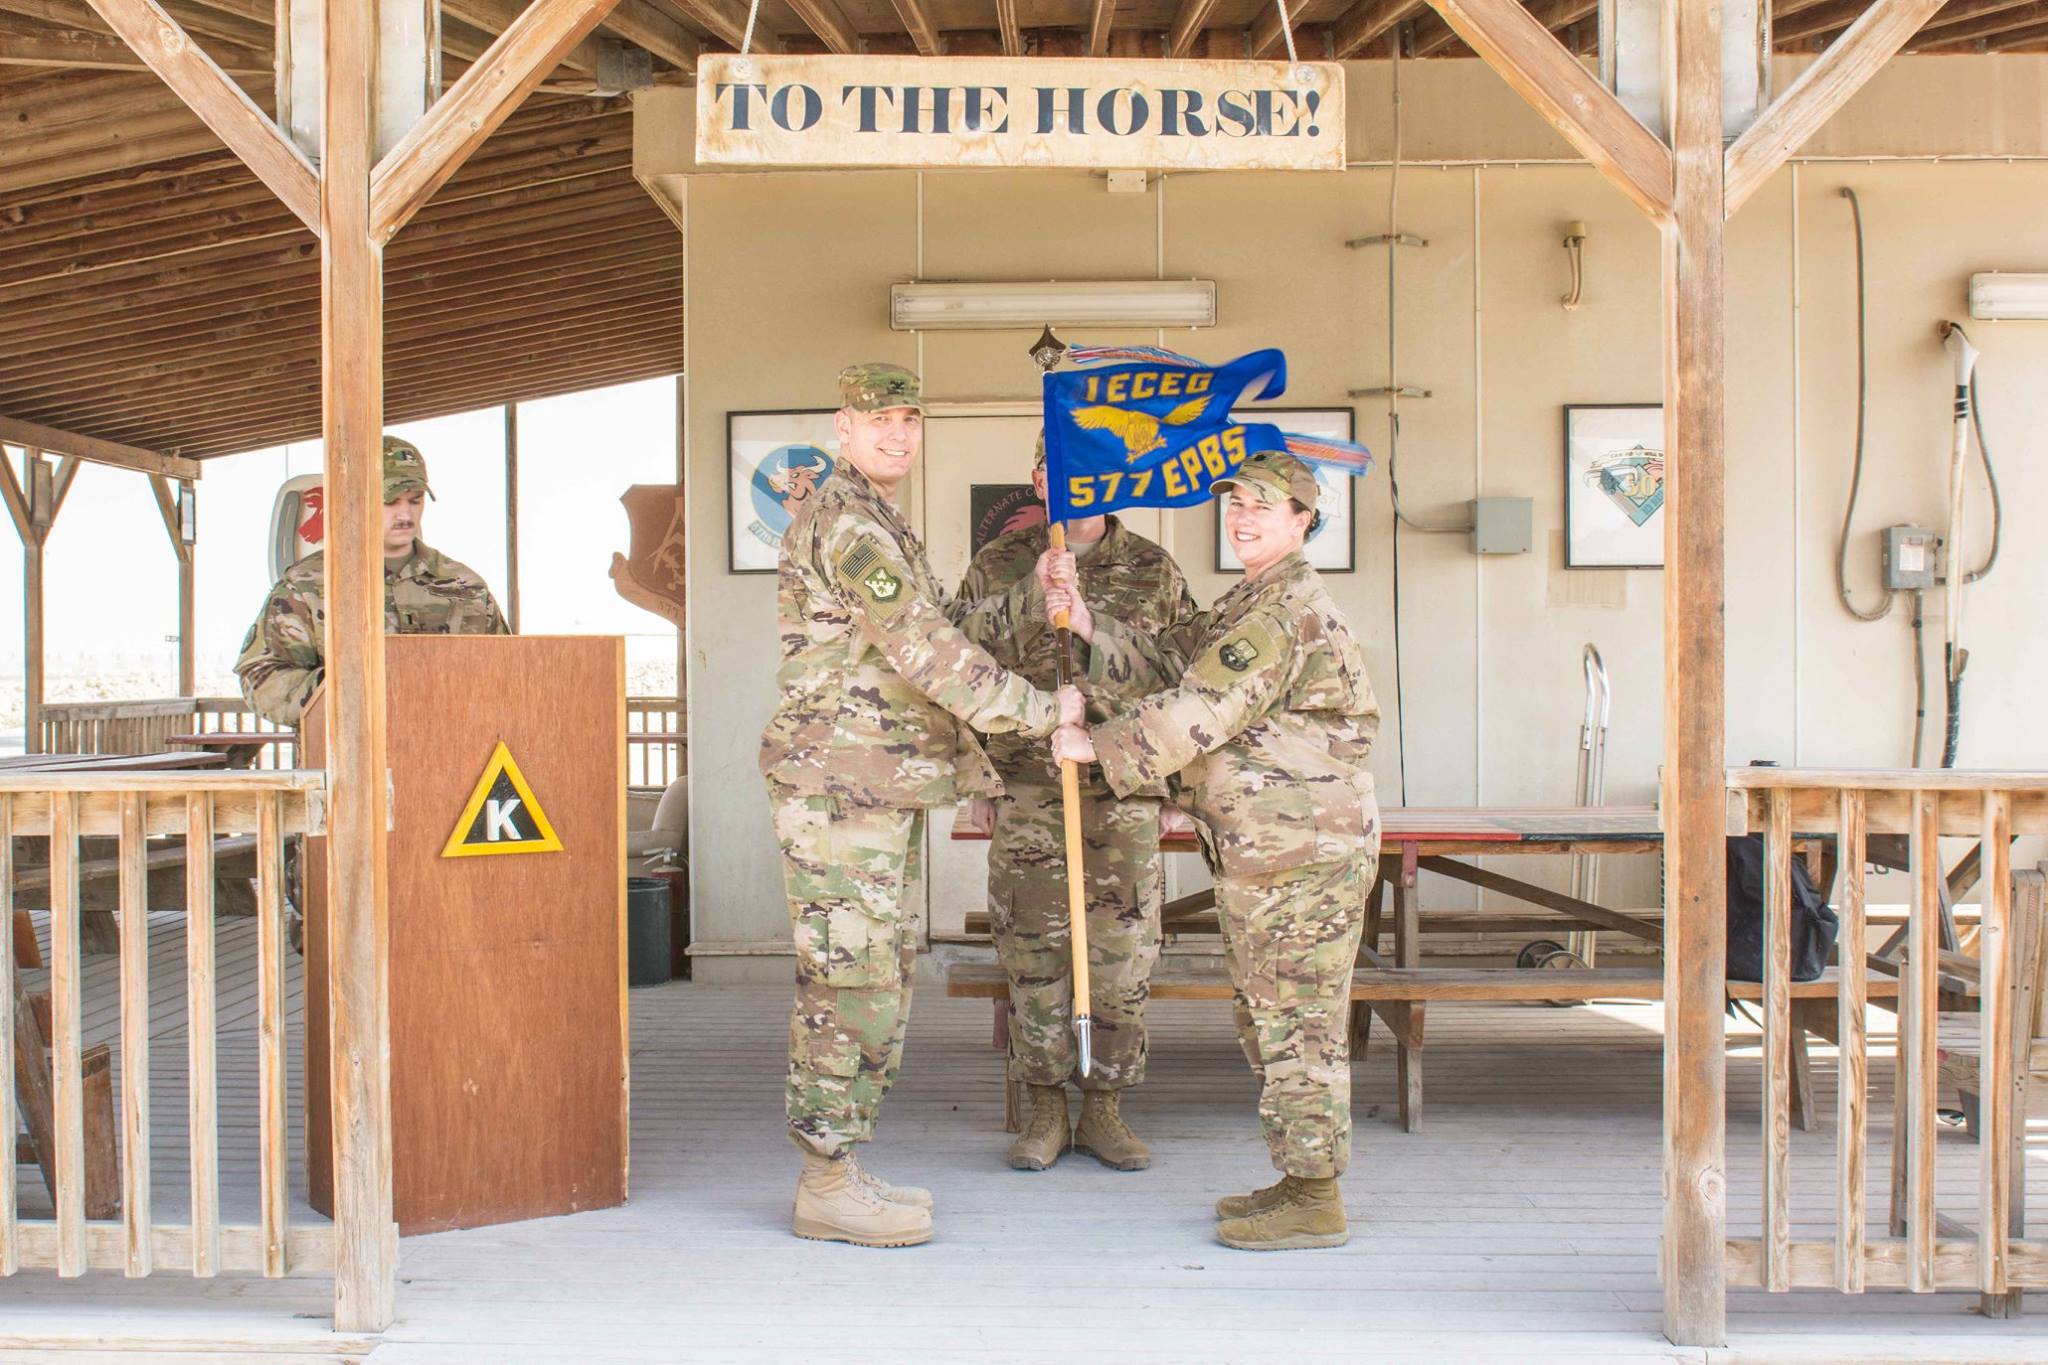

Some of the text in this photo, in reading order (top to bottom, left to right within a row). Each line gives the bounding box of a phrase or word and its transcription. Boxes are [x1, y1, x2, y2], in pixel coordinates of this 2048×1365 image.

[714, 83, 1321, 138] TO THE HORSE!
[1068, 425, 1248, 508] 577 EPBS
[975, 488, 1023, 546] ALTERNATE
[486, 798, 522, 842] K
